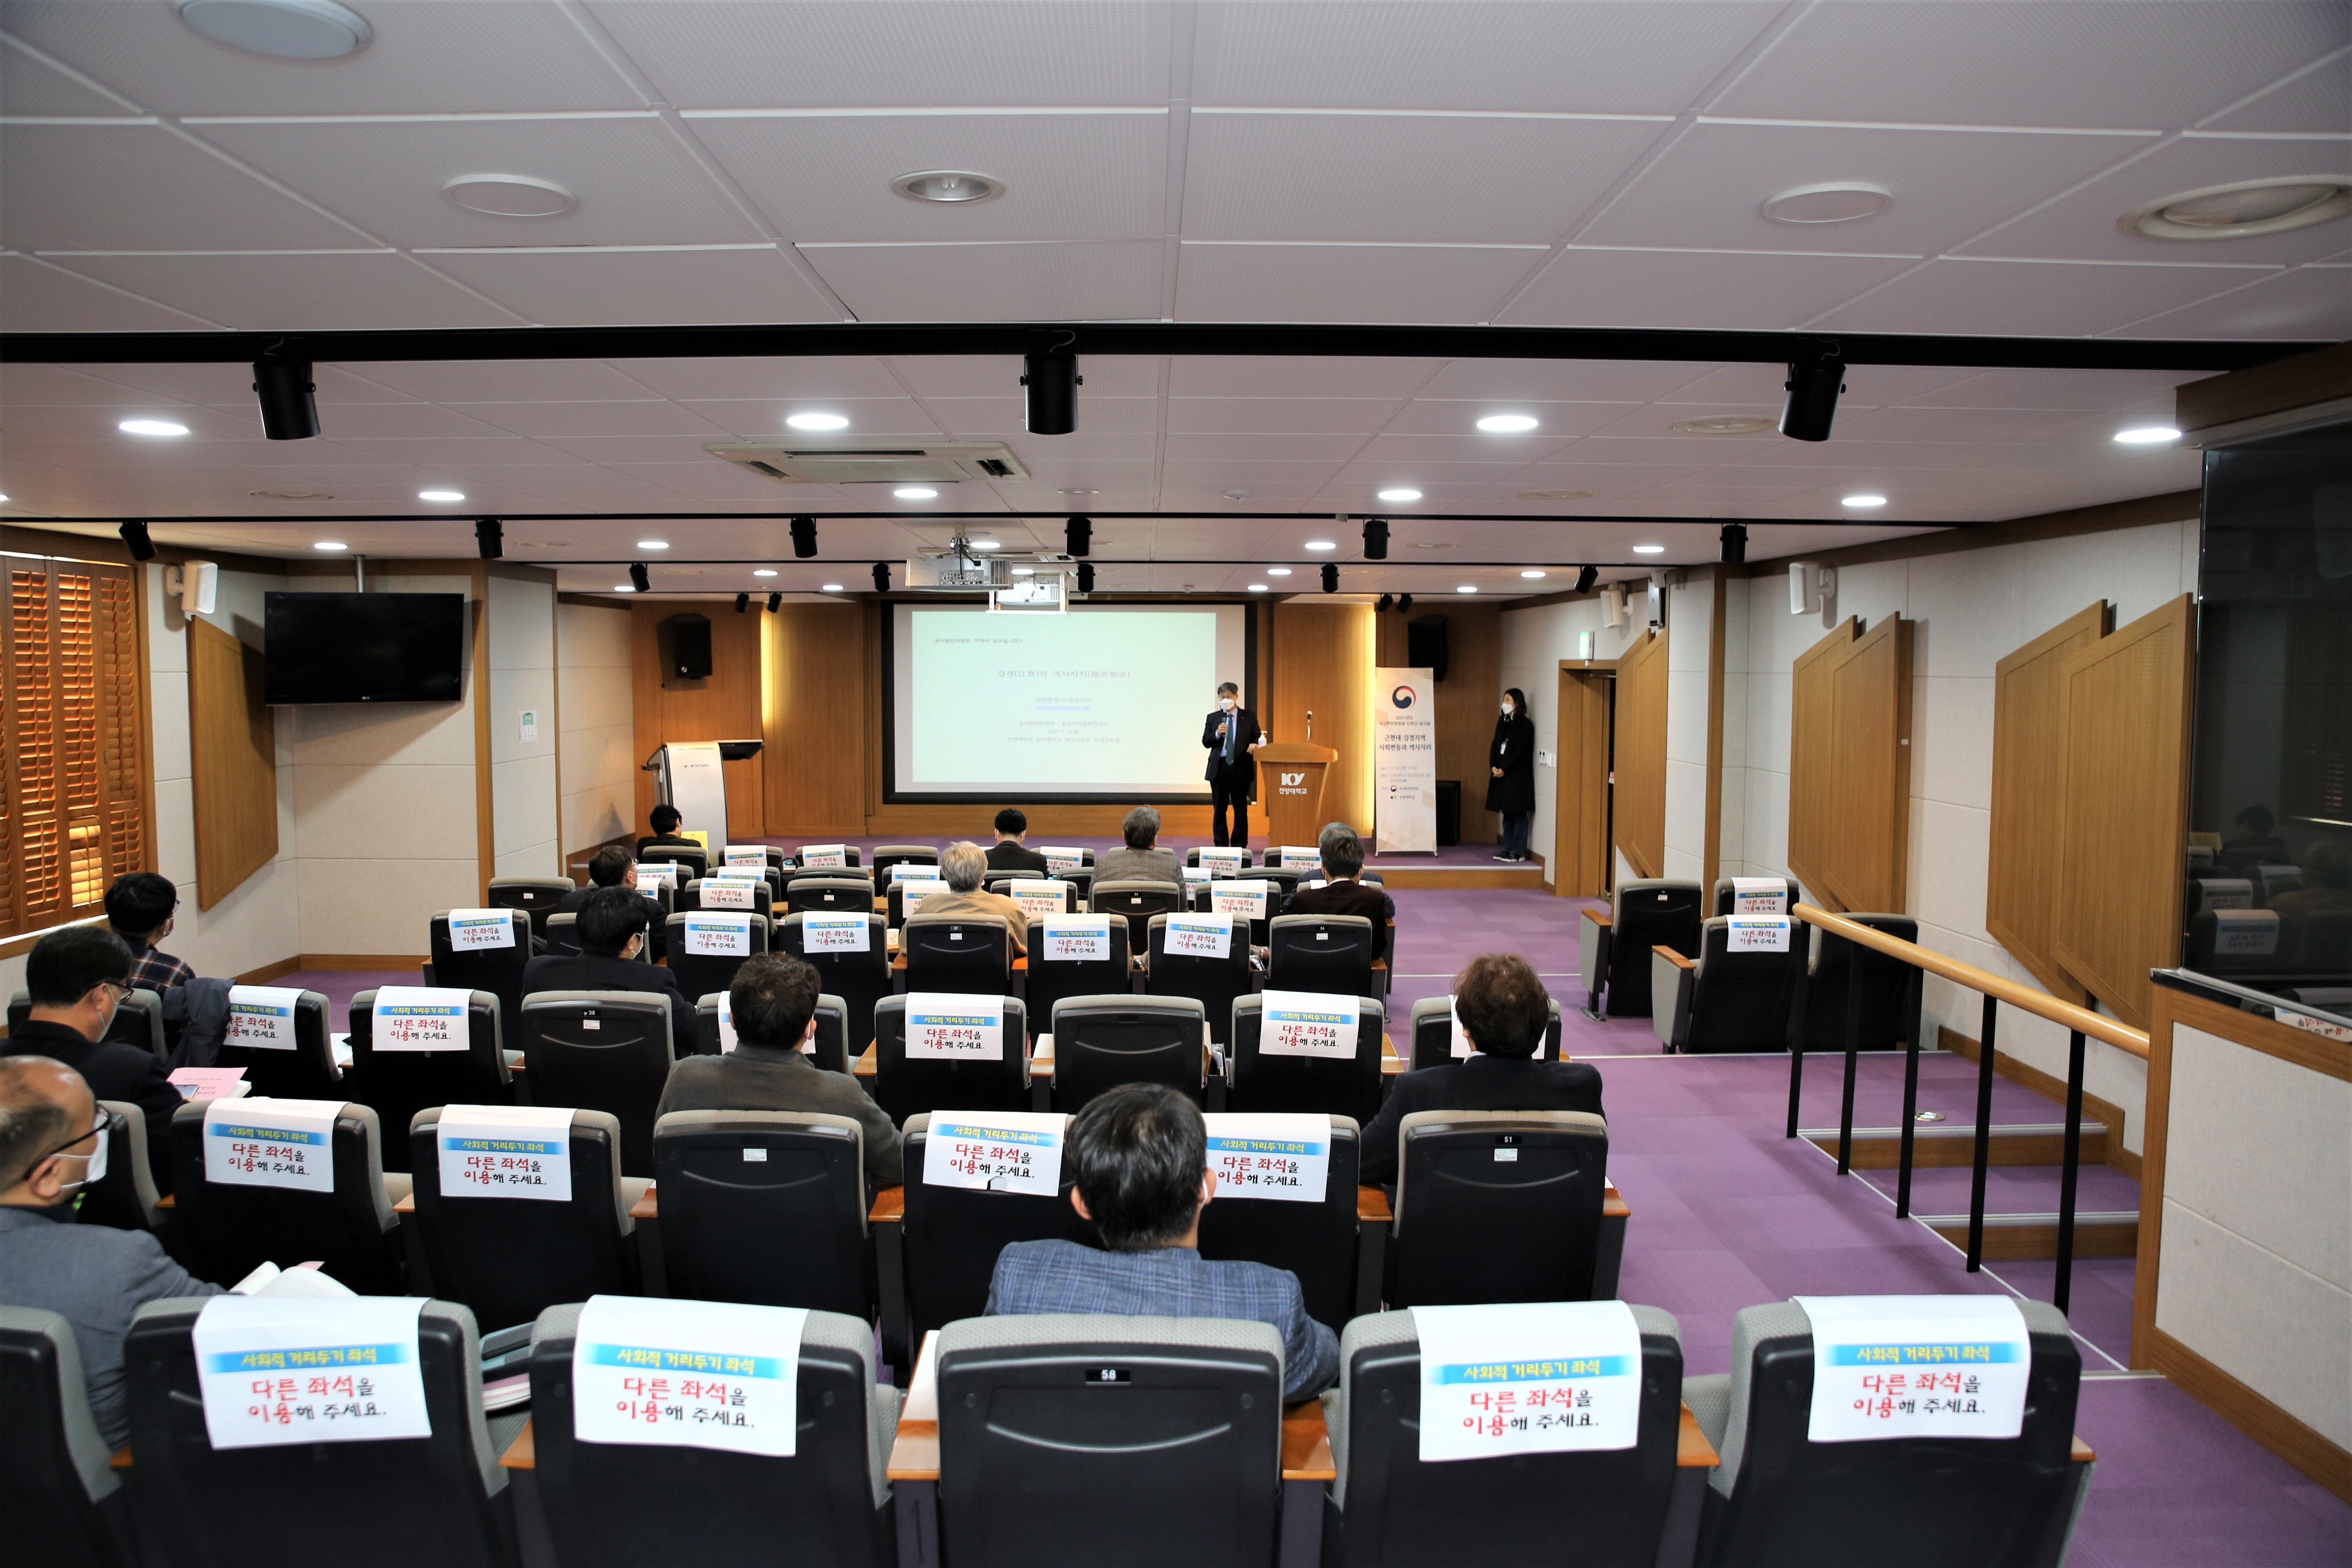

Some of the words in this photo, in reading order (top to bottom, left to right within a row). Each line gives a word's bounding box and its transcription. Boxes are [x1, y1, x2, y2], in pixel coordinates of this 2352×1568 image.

[715, 933, 735, 942] 좌석을
[1177, 941, 1197, 949] 이용해
[1180, 933, 1194, 942] 다른
[1196, 935, 1217, 943] 좌석을
[412, 1007, 436, 1015] 거리두기
[437, 1007, 450, 1015] 좌석
[1280, 1013, 1300, 1021] 사회적
[1301, 1013, 1326, 1022] 거리두기
[1326, 1014, 1341, 1022] 좌석
[248, 1018, 275, 1029] 좌석을
[394, 1019, 414, 1029] 다른
[417, 1019, 448, 1030] 좌석을
[945, 1017, 970, 1025] 거리두기
[253, 1030, 278, 1038] 주세요.
[390, 1030, 419, 1040] 이용해
[422, 1032, 451, 1040] 주세요.
[927, 1028, 947, 1039] 다른
[951, 1029, 982, 1039] 좌석을
[1282, 1025, 1303, 1036] 다른
[1307, 1026, 1337, 1037] 좌석을
[924, 1039, 953, 1049] 이용해
[1278, 1036, 1307, 1046] 이용해
[1311, 1038, 1339, 1047] 주세요.
[227, 1127, 254, 1139] 사회적
[256, 1129, 289, 1142] 거리두기
[290, 1131, 308, 1143] 좌석
[953, 1125, 982, 1139] 사회적
[983, 1128, 1018, 1141] 거리두기
[1018, 1131, 1038, 1143] 좌석
[232, 1143, 260, 1158] 다른
[265, 1146, 305, 1162] 좌석을
[462, 1139, 489, 1150] 사회적
[491, 1140, 524, 1151] 거리두기
[525, 1141, 544, 1152] 좌석
[956, 1143, 985, 1160] 다른
[990, 1147, 1031, 1164] 좌석을
[1220, 1138, 1248, 1151] 사회적
[1250, 1139, 1285, 1151] 거리두기
[1285, 1141, 1304, 1153] 좌석
[228, 1158, 267, 1173] 이용해
[272, 1163, 310, 1175] 주세요.
[467, 1156, 496, 1170] 다른
[501, 1157, 541, 1172] 좌석을
[950, 1159, 991, 1175] 이용해
[995, 1165, 1034, 1178] 주세요.
[1223, 1156, 1252, 1170] 다른
[1257, 1157, 1298, 1173] 좌석을
[464, 1171, 504, 1184] 이용해
[508, 1174, 547, 1185] 주세요.
[1218, 1171, 1258, 1185] 이용해
[1263, 1175, 1302, 1185] 주세요.
[238, 1350, 285, 1368] 사회적
[287, 1347, 345, 1365] 거리두기
[345, 1346, 378, 1365] 좌석
[617, 1348, 662, 1368] 사회적
[666, 1351, 722, 1372] 거리두기
[724, 1355, 755, 1374] 좌석
[1857, 1345, 1900, 1363] 사회적
[1903, 1344, 1958, 1361] 거리두기
[1958, 1343, 1990, 1362] 좌석
[1101, 1369, 1116, 1381] 58
[1463, 1362, 1506, 1380] 사회적
[1509, 1359, 1566, 1378] 거리두기
[1568, 1357, 1601, 1377] 좌석
[251, 1378, 299, 1401] 다른
[306, 1374, 375, 1398] 좌석을
[624, 1376, 671, 1401] 다른
[680, 1379, 747, 1406] 좌석을
[1861, 1373, 1907, 1395] 다른
[1914, 1371, 1980, 1394] 좌석을
[1470, 1390, 1515, 1412] 다른
[1524, 1386, 1592, 1410] 좌석을
[1853, 1396, 1915, 1418] 이용해
[1922, 1398, 1985, 1414] 주세요.
[248, 1401, 315, 1425] 이용해
[322, 1401, 387, 1419] 주세요.
[617, 1401, 683, 1424] 이용해
[692, 1407, 755, 1428] 주세요.
[1463, 1413, 1526, 1436] 이용해
[1535, 1414, 1598, 1430] 주세요.
